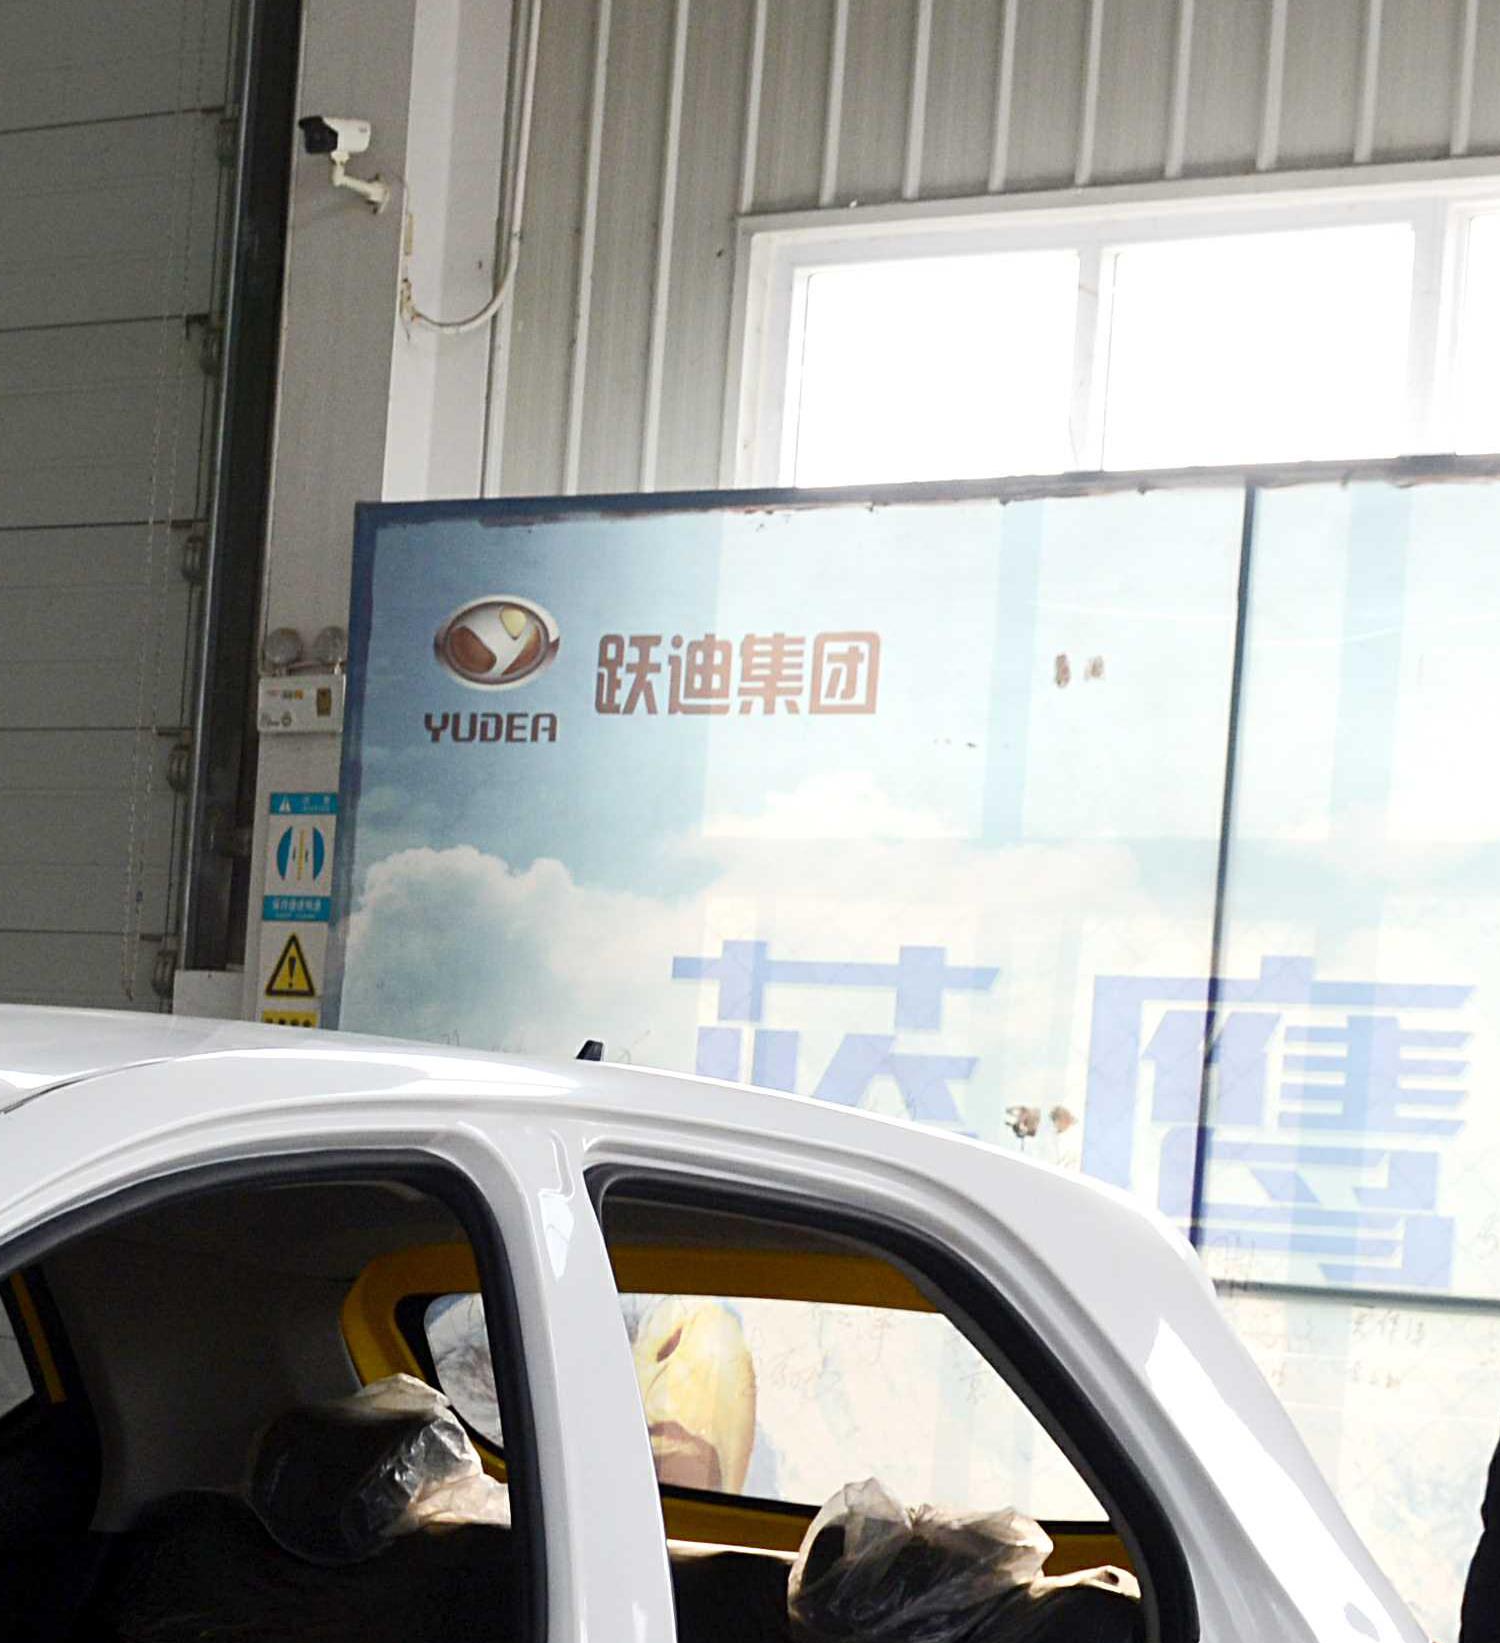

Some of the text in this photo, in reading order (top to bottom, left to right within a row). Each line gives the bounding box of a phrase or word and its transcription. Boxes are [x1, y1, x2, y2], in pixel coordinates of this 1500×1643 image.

[594, 631, 882, 716] 跃迪集团
[424, 712, 558, 744] YUDEA
